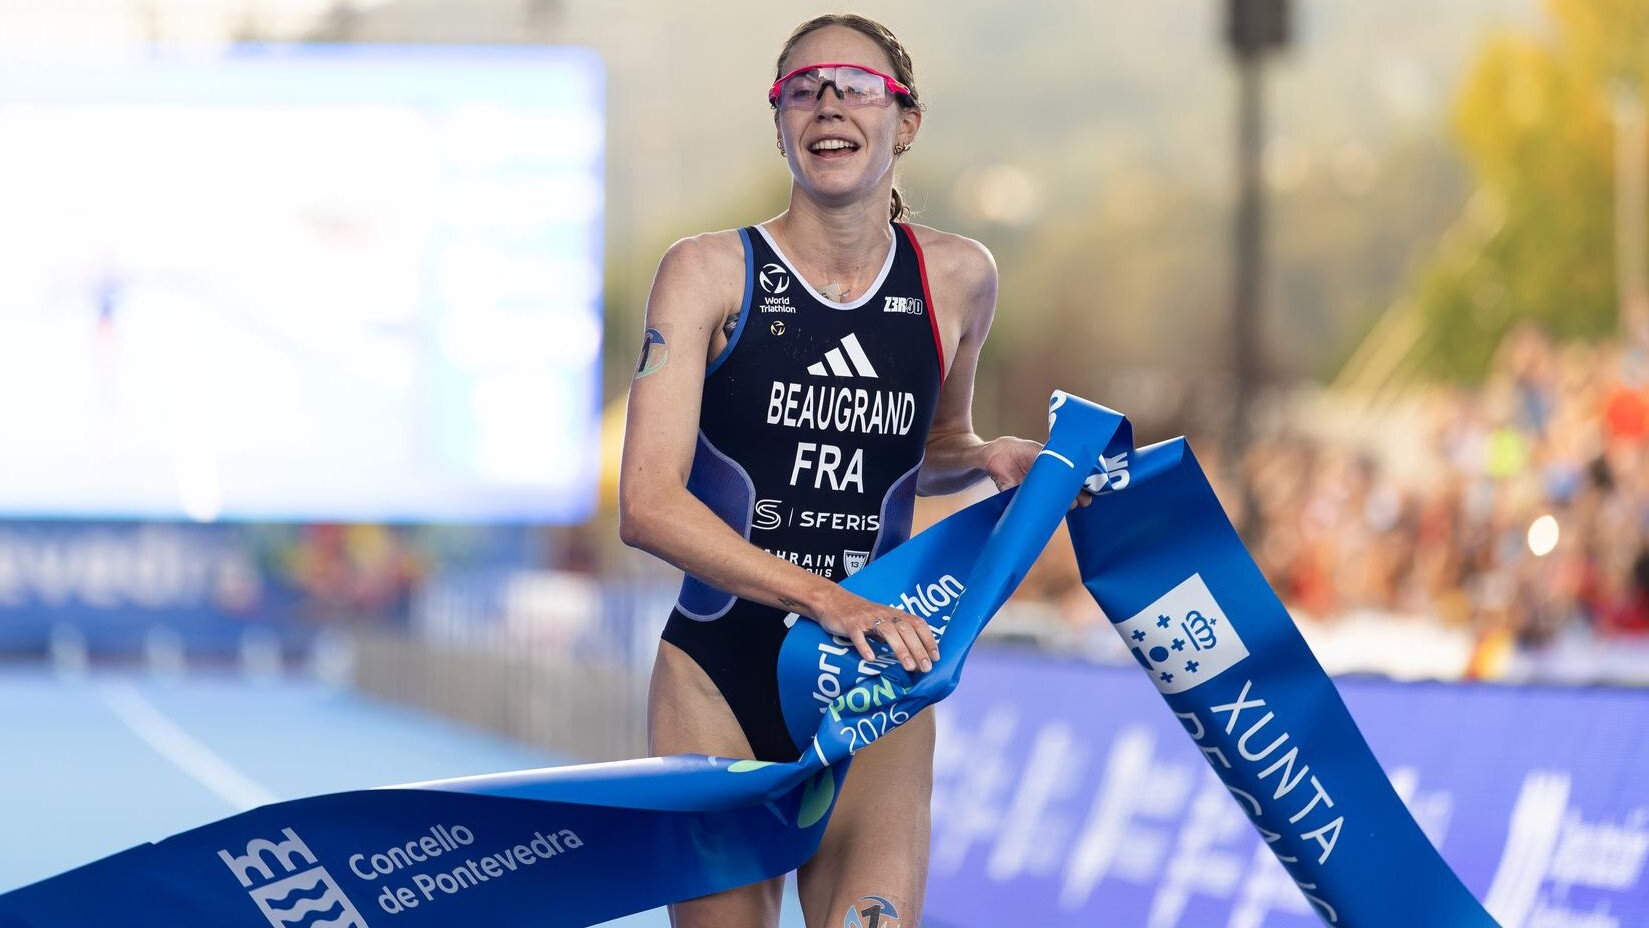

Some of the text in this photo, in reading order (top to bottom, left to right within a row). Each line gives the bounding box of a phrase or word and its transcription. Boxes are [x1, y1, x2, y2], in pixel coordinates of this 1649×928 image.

[759, 305, 797, 314] Triathlon
[765, 297, 790, 306] World
[766, 380, 916, 436] BEAUGRAND
[789, 441, 864, 494] FRA
[889, 574, 965, 617] hlon
[840, 703, 910, 755] 2026
[1210, 680, 1344, 865] XUNTA
[348, 823, 475, 881] Concello
[377, 828, 585, 915] de Pontevedra
